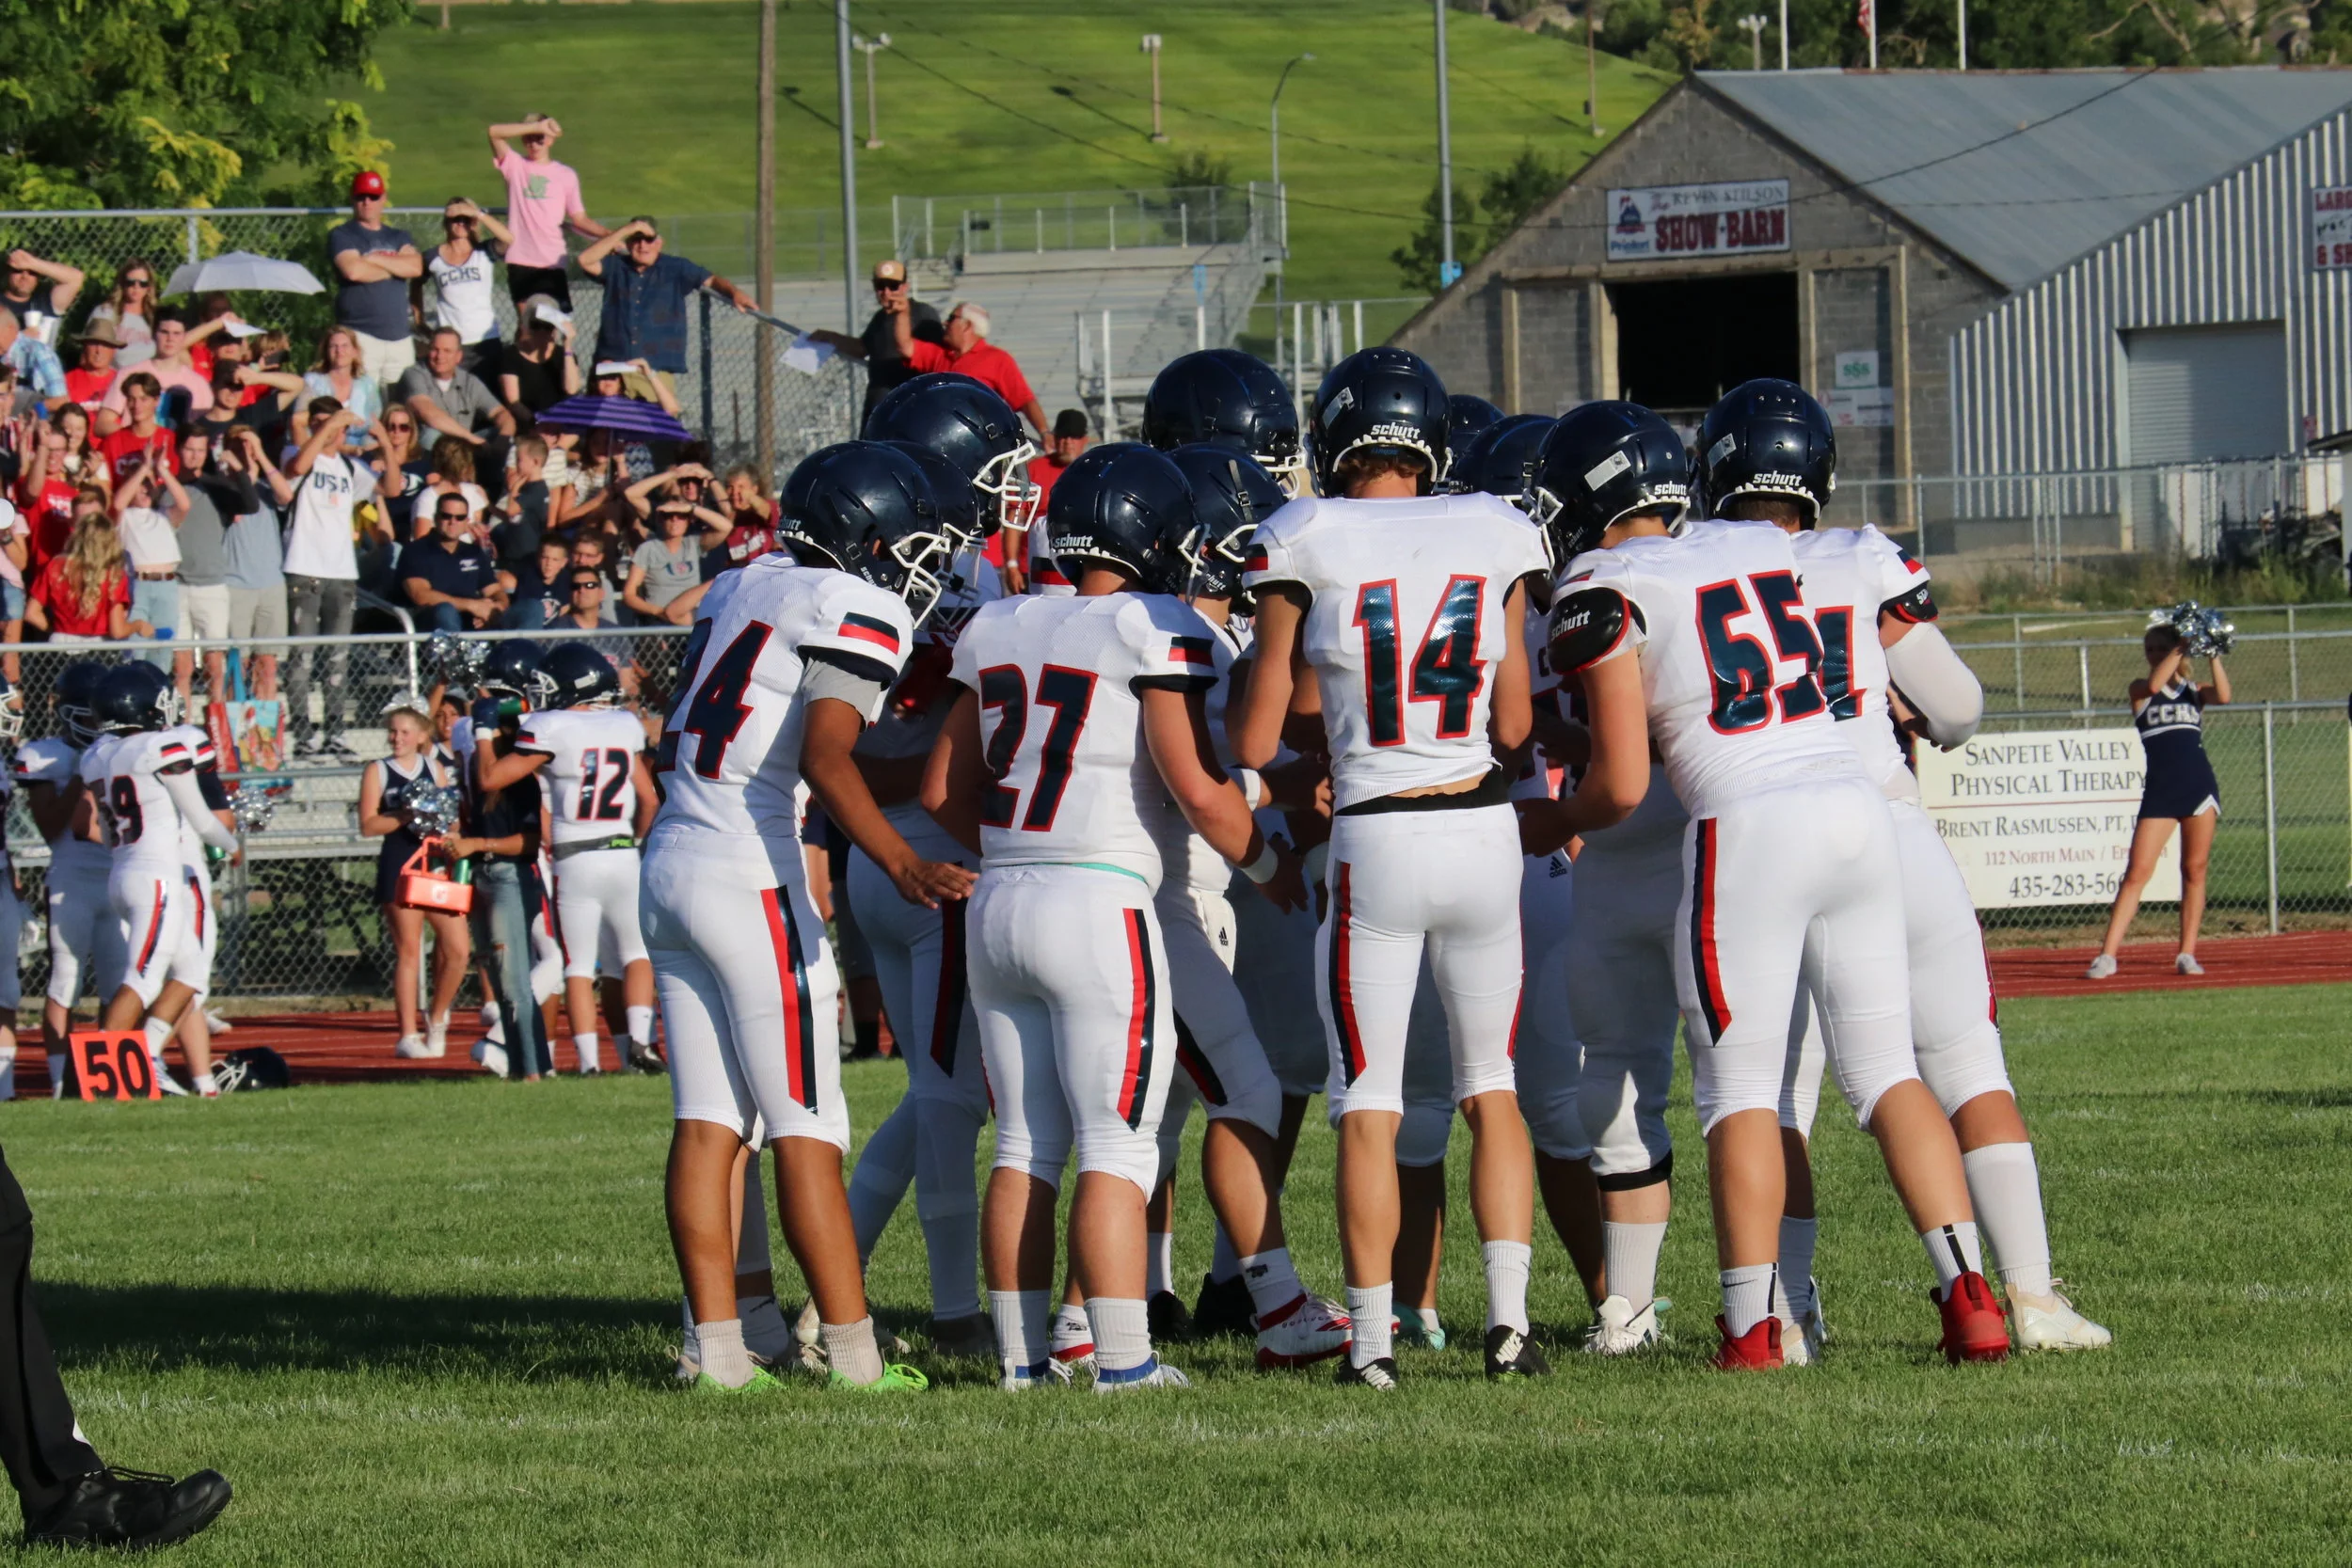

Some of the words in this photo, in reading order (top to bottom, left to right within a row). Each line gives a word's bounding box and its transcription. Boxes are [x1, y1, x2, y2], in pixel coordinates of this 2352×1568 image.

[1655, 213, 1719, 252] SHOW
[1725, 209, 1786, 248] BARN
[438, 267, 482, 287] CCHS
[1370, 422, 1422, 440] schutt
[313, 470, 351, 494] USA
[1753, 470, 1804, 487] schutt
[1054, 533, 1093, 548] schutt
[1551, 610, 1591, 641] schutt
[1352, 574, 1489, 747] 14
[1695, 569, 1825, 736] 65
[977, 662, 1100, 832] 27
[1965, 742, 2054, 767] SANPETE
[2058, 738, 2133, 762] VALLEY
[576, 747, 630, 821] 12
[1950, 772, 2053, 797] PHYSICAL
[2058, 768, 2146, 793] THERAPY
[1936, 818, 1993, 838] BRENT
[1995, 815, 2102, 837] RASMUSSEN,
[1985, 850, 2007, 866] 112
[2010, 847, 2056, 865] NORTH
[2058, 847, 2096, 863] MAIN
[2009, 871, 2126, 899] 435-283-56
[85, 1037, 152, 1100] 50
